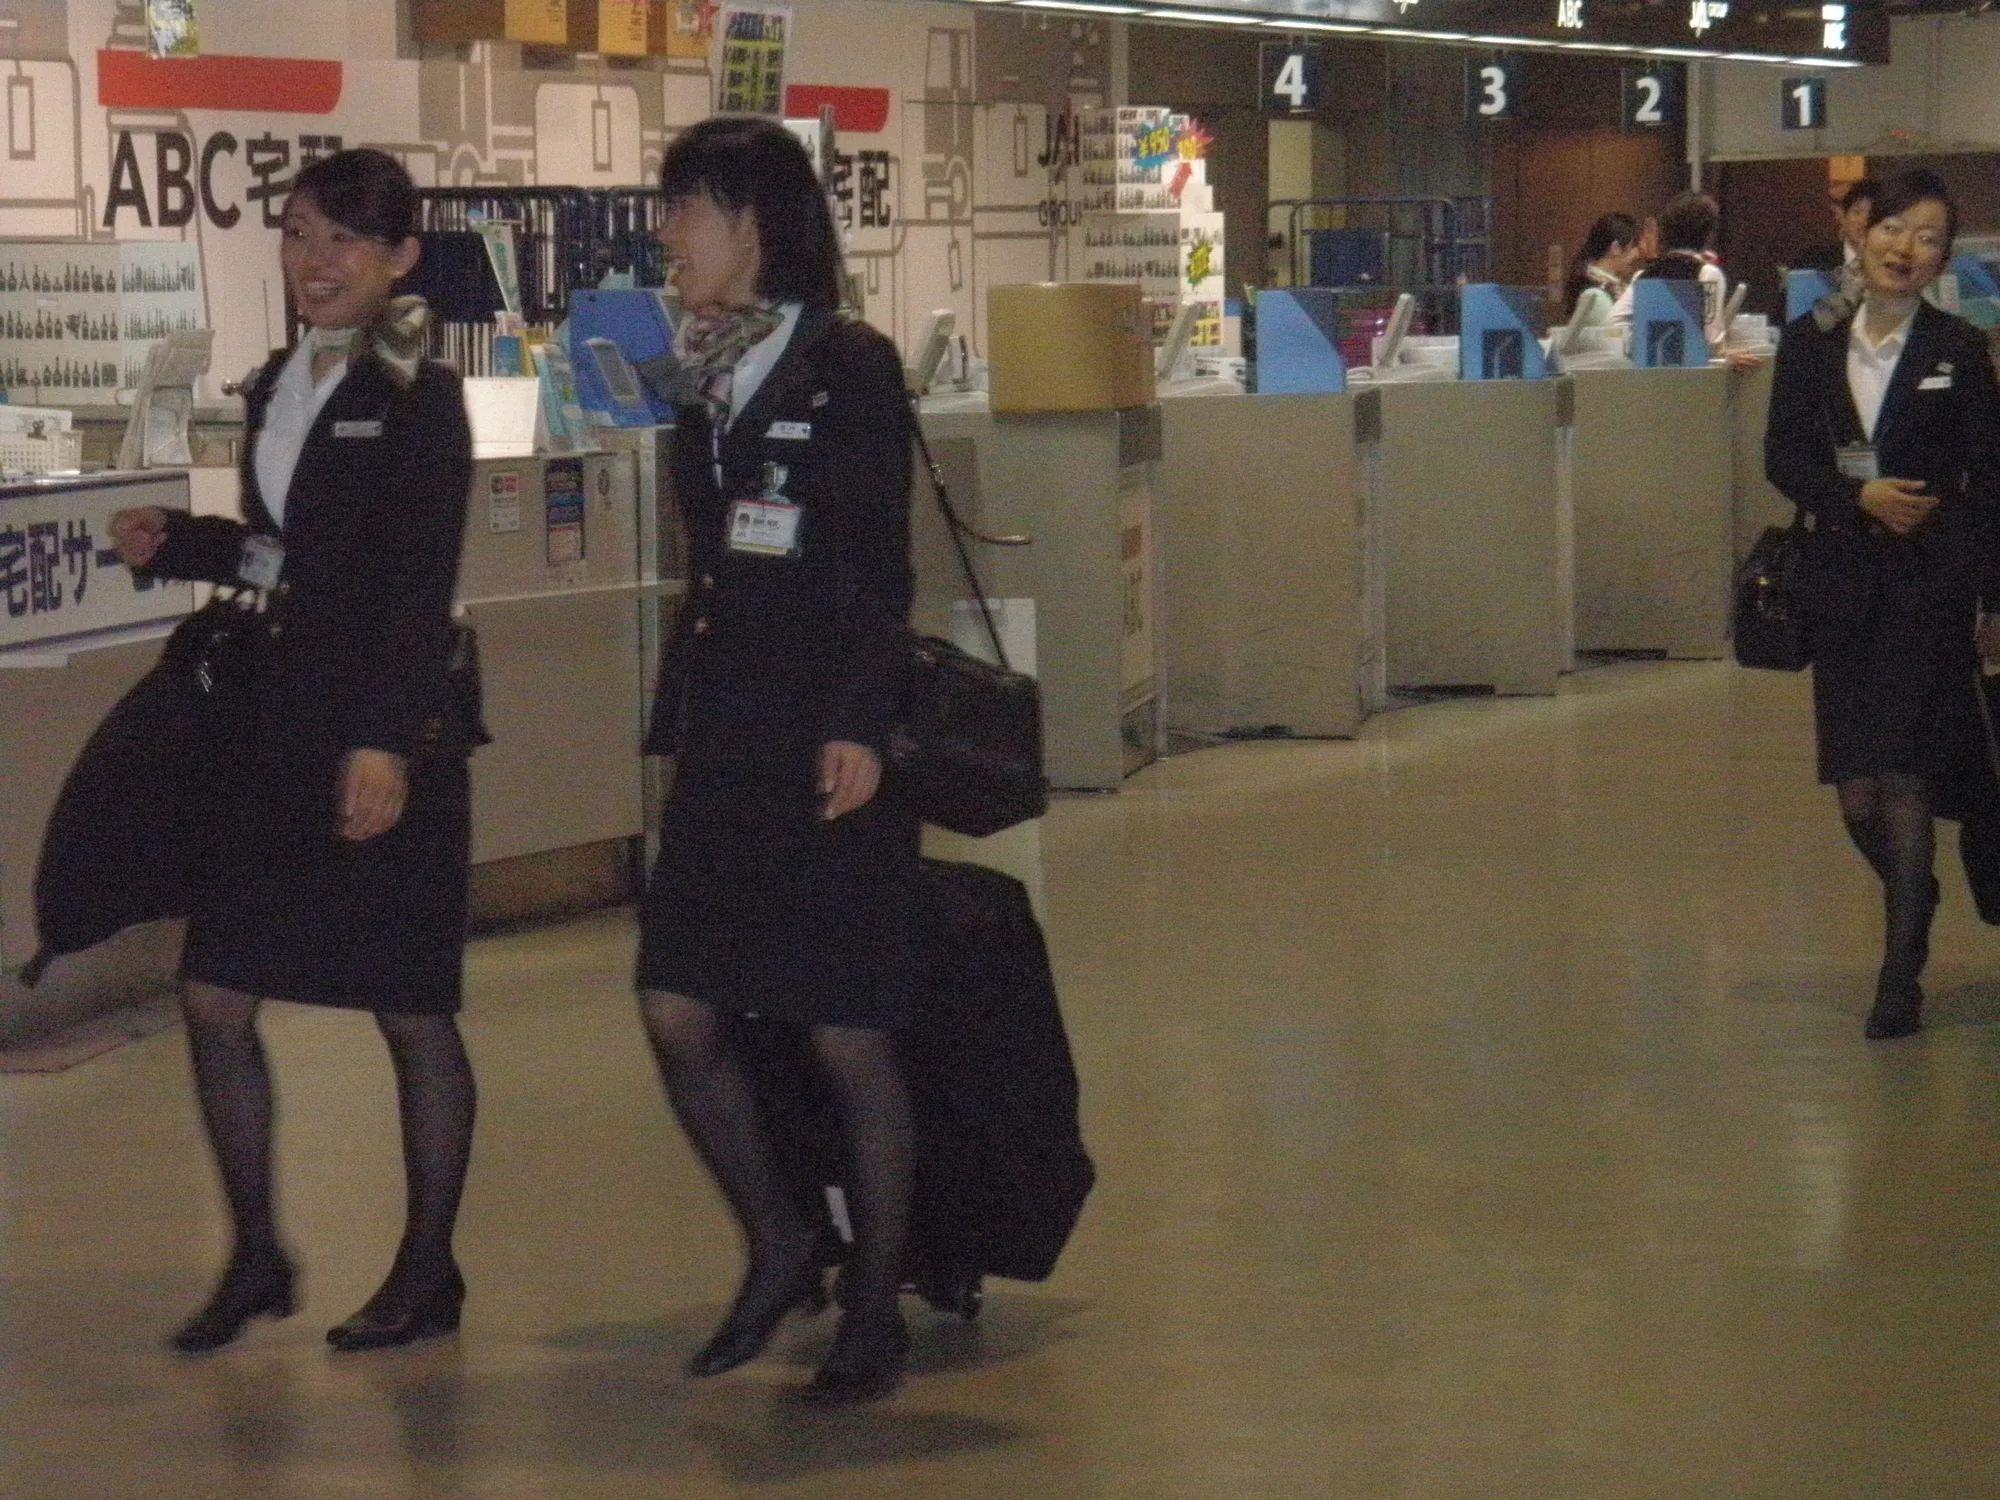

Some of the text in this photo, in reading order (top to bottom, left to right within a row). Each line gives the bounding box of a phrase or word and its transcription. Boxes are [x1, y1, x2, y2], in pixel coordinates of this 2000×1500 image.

[1274, 54, 1307, 106] 4
[1478, 66, 1507, 115] 3
[1635, 77, 1662, 122] 2
[1792, 85, 1811, 127] 1
[103, 129, 343, 229] ABC宅
